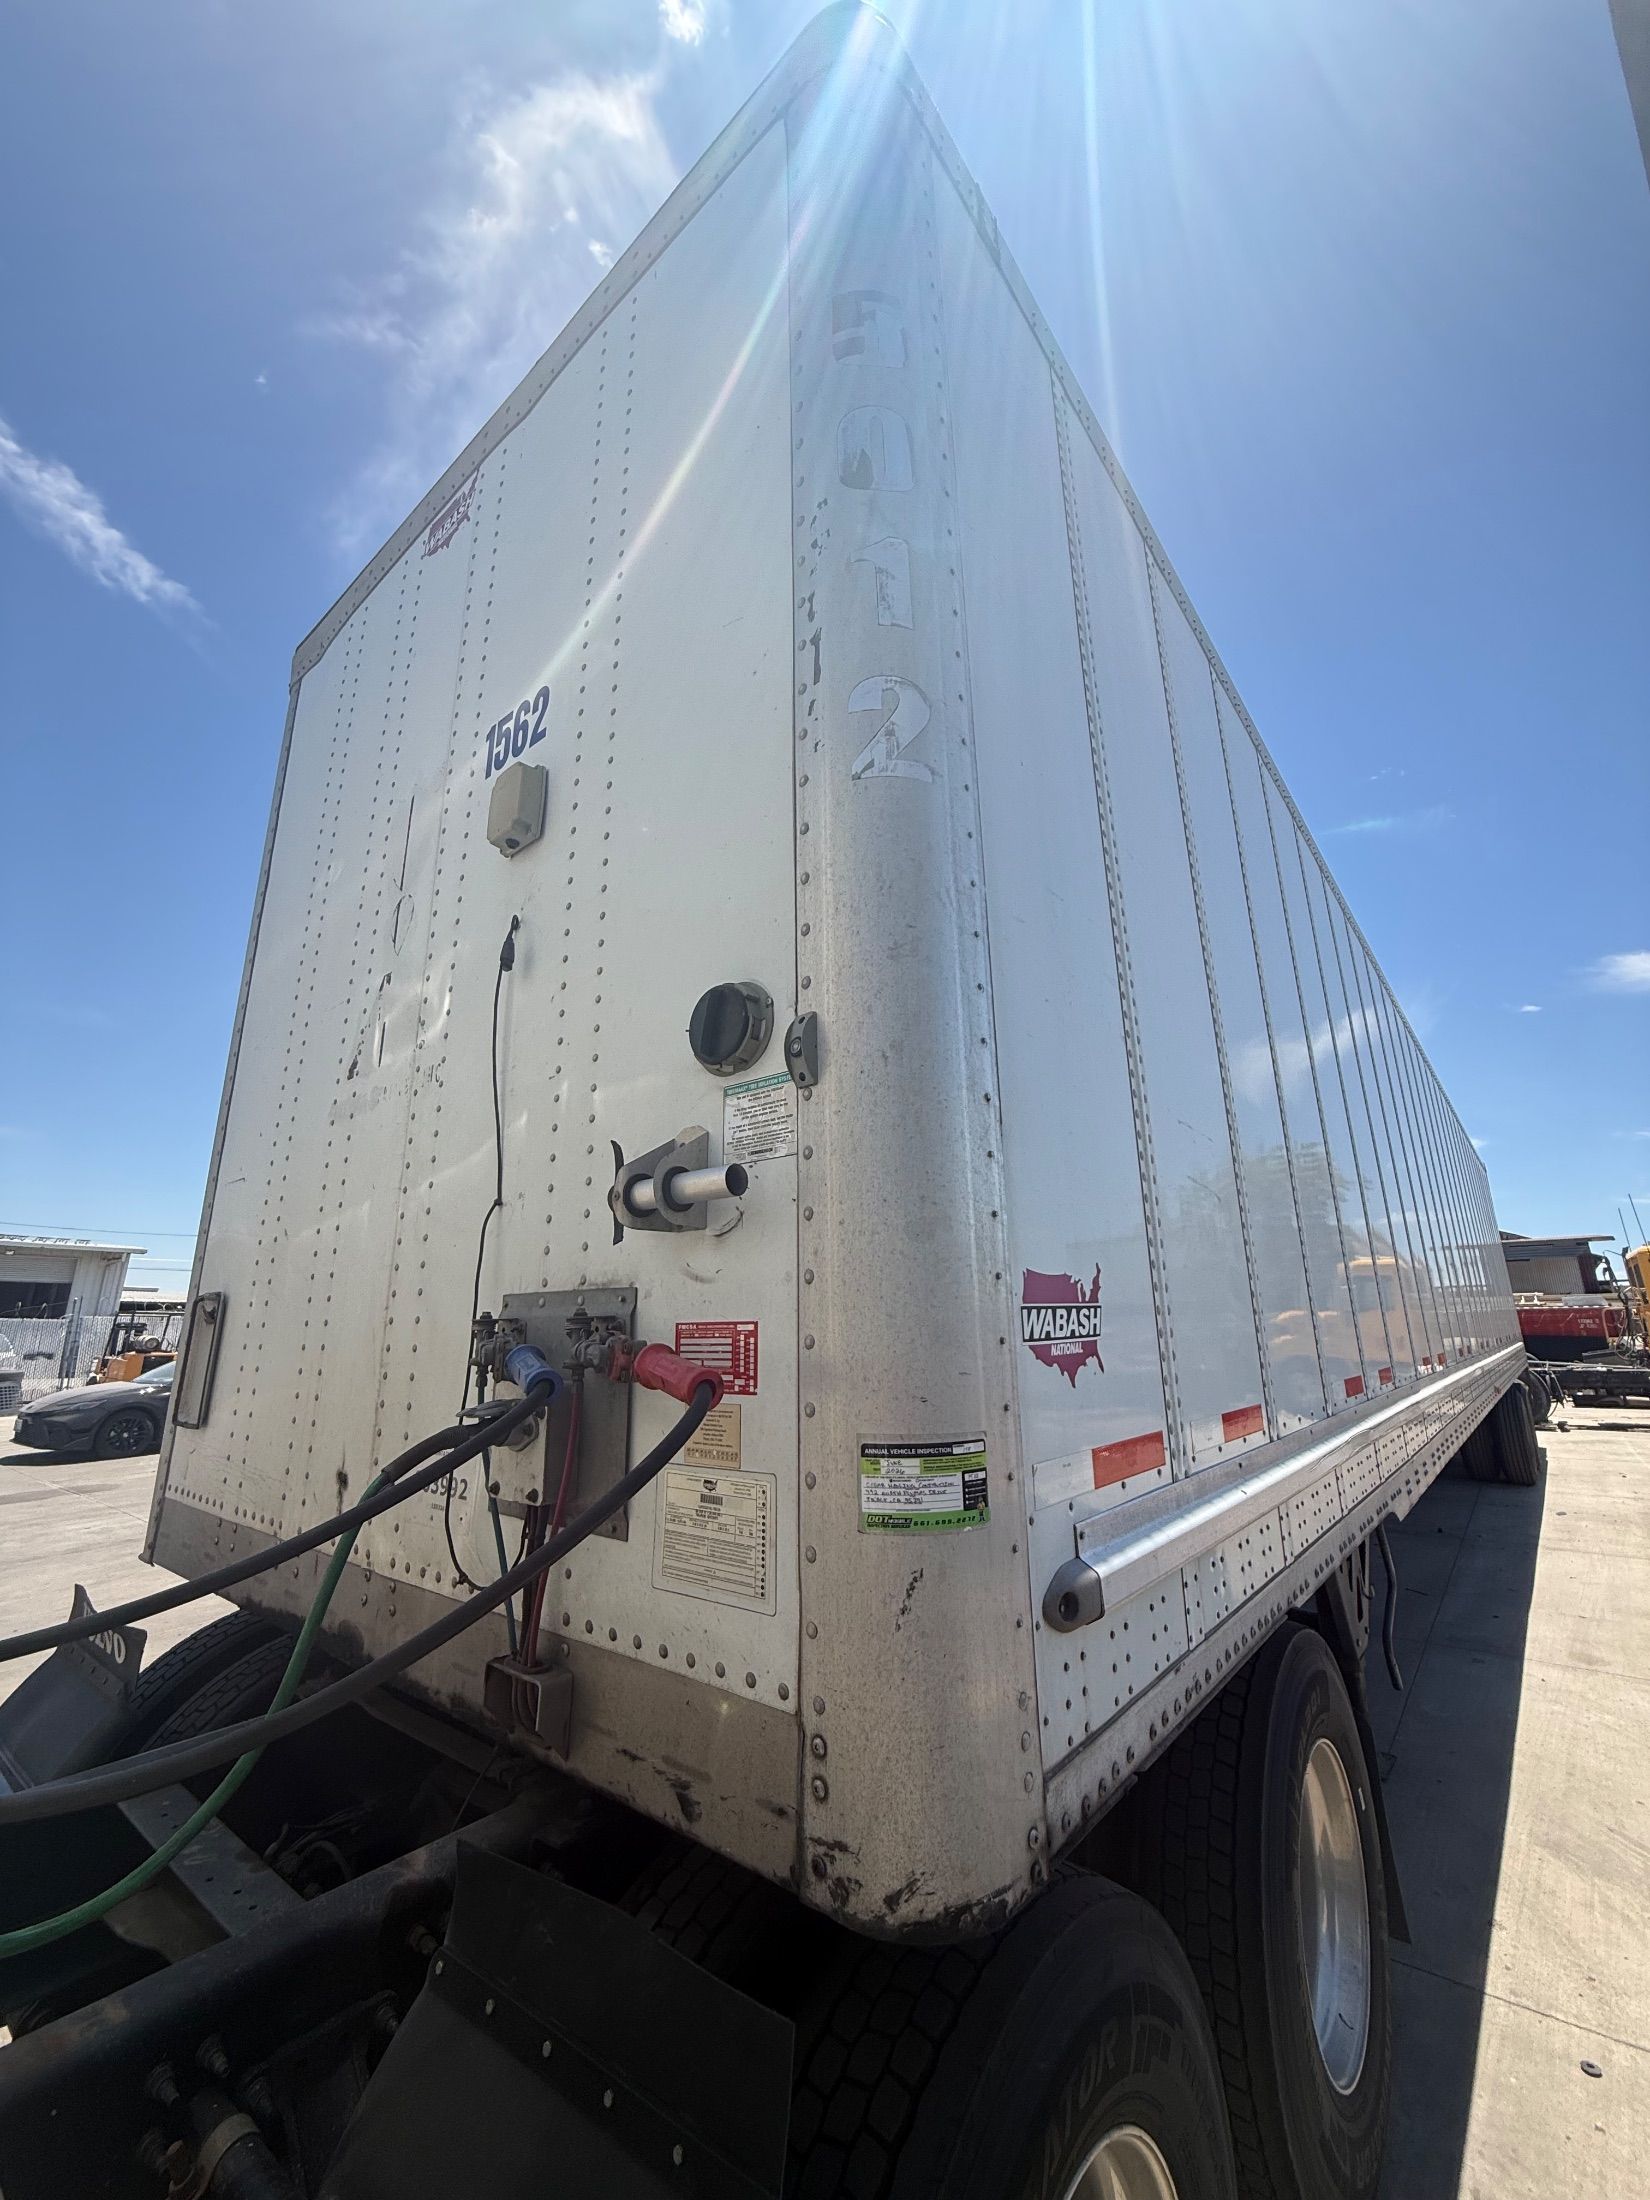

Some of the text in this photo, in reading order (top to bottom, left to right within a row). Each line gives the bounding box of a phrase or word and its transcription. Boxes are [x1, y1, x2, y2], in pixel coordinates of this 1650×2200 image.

[484, 685, 551, 781] 1562
[1022, 1307, 1101, 1340] WABASH
[1051, 1342, 1083, 1356] NATIONAL
[917, 1447, 952, 1455] INSPECTION
[867, 1515, 889, 1523] DOT
